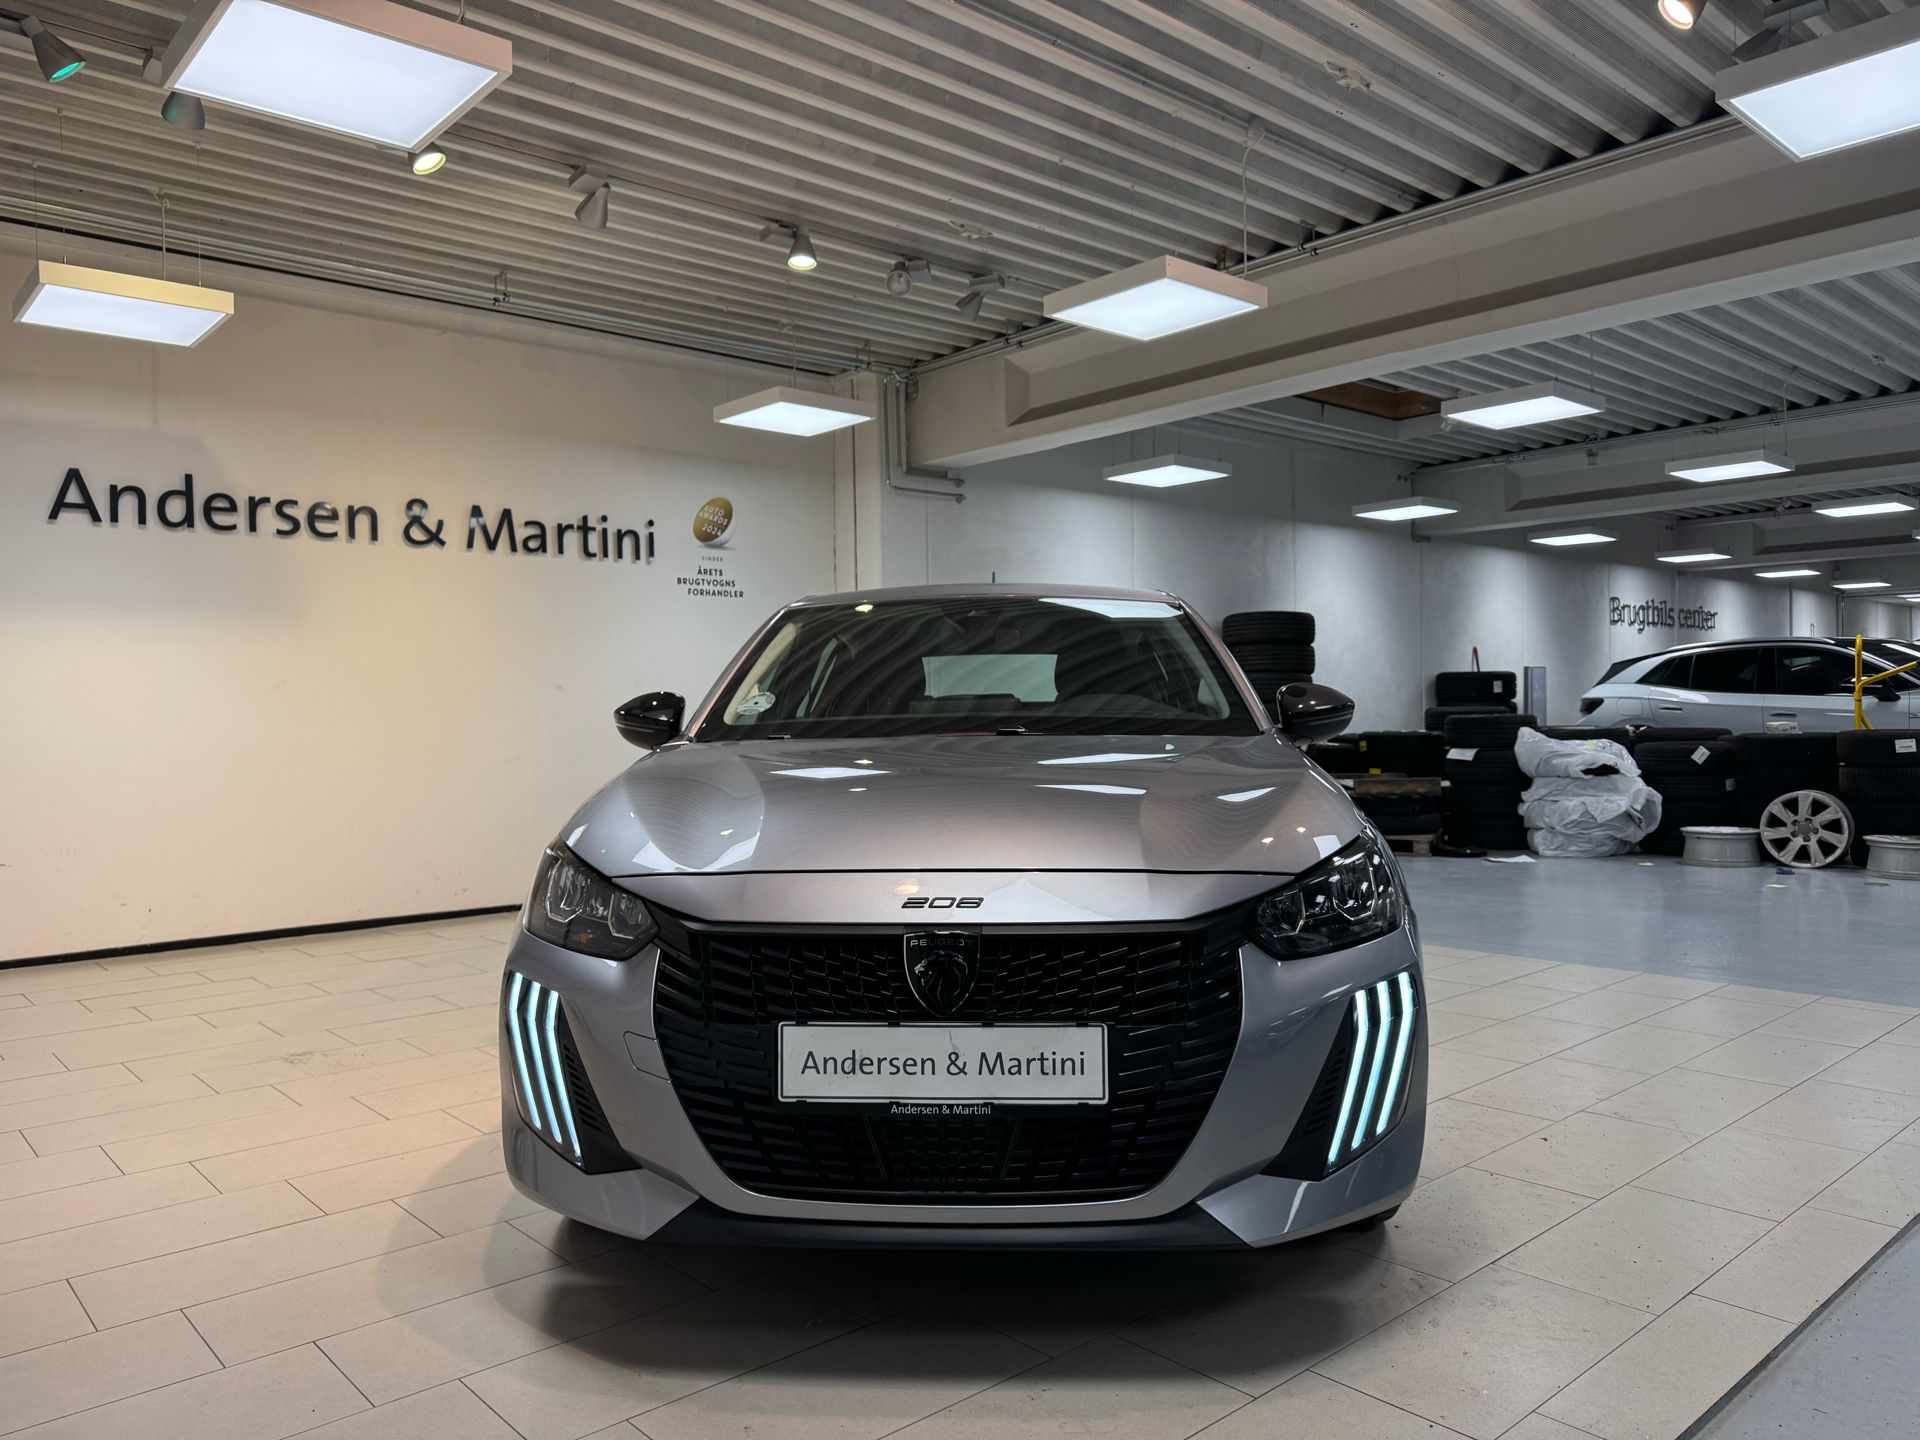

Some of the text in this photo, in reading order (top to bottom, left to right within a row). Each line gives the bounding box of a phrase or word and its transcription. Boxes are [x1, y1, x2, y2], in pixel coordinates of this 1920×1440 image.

[48, 467, 655, 561] Andersen & Martini
[703, 505, 725, 517] AUTO
[698, 510, 729, 526] AWARDS
[702, 523, 722, 536] 2024
[697, 565, 723, 577] ÅRETS
[677, 577, 736, 588] BRUGTVOGNS
[687, 588, 744, 598] FORHANDLER
[1609, 596, 1718, 634] Brugtbils center
[901, 896, 985, 909] 208
[910, 938, 974, 947] PEUGEOT
[800, 1049, 1086, 1077] Andersen & Martini
[890, 1104, 992, 1116] Andersen & Martini
